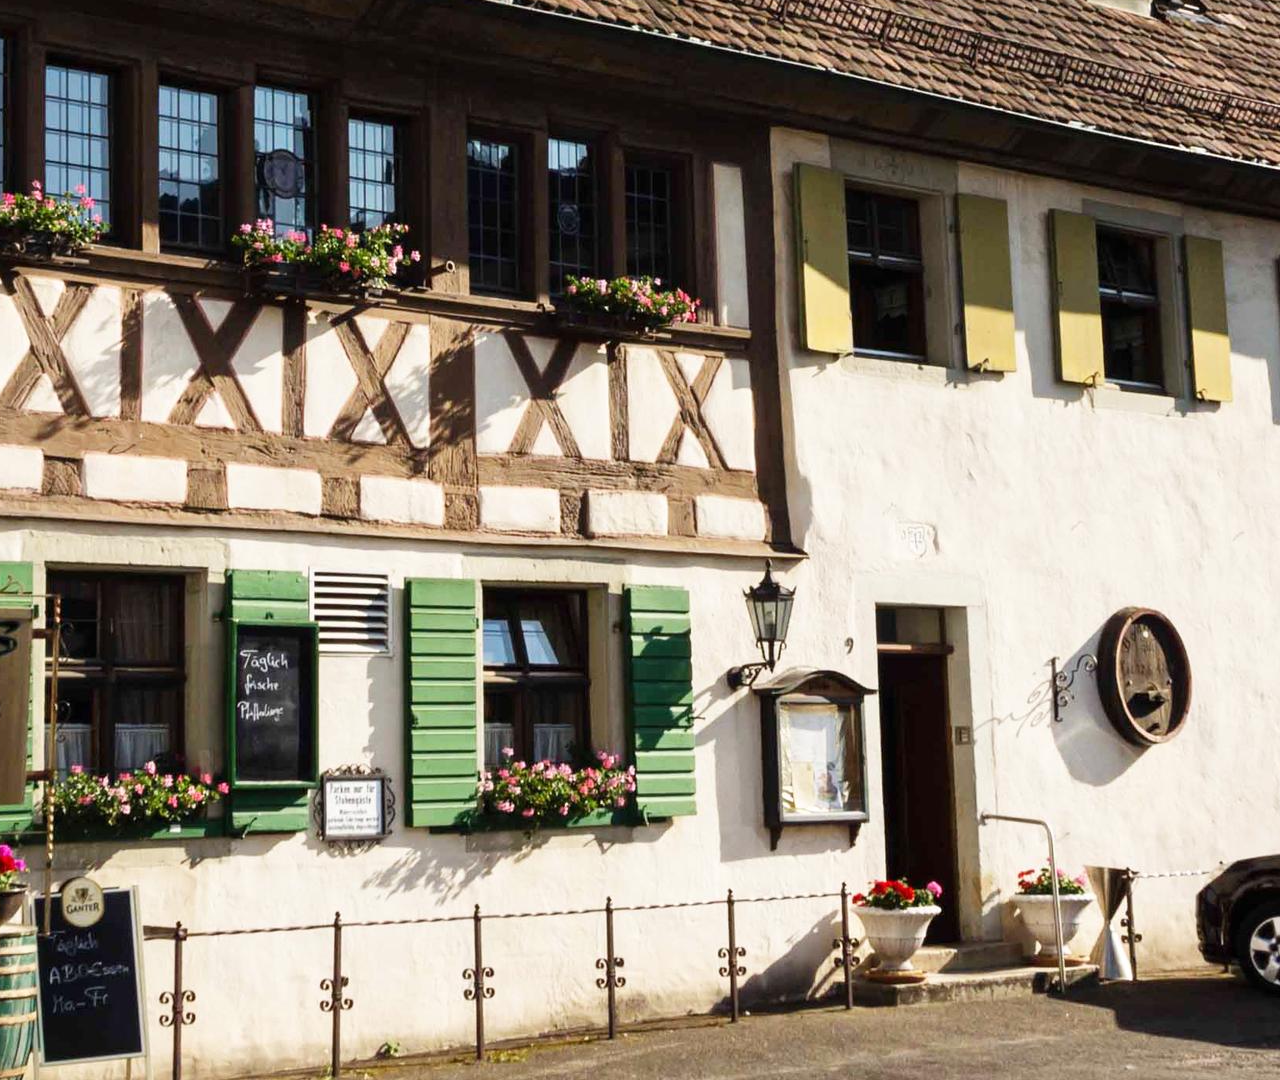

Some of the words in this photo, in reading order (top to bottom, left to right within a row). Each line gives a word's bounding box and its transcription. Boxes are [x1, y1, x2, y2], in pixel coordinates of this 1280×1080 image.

[239, 649, 288, 673] Täglich
[244, 673, 280, 696] frische
[66, 901, 100, 915] GANTER
